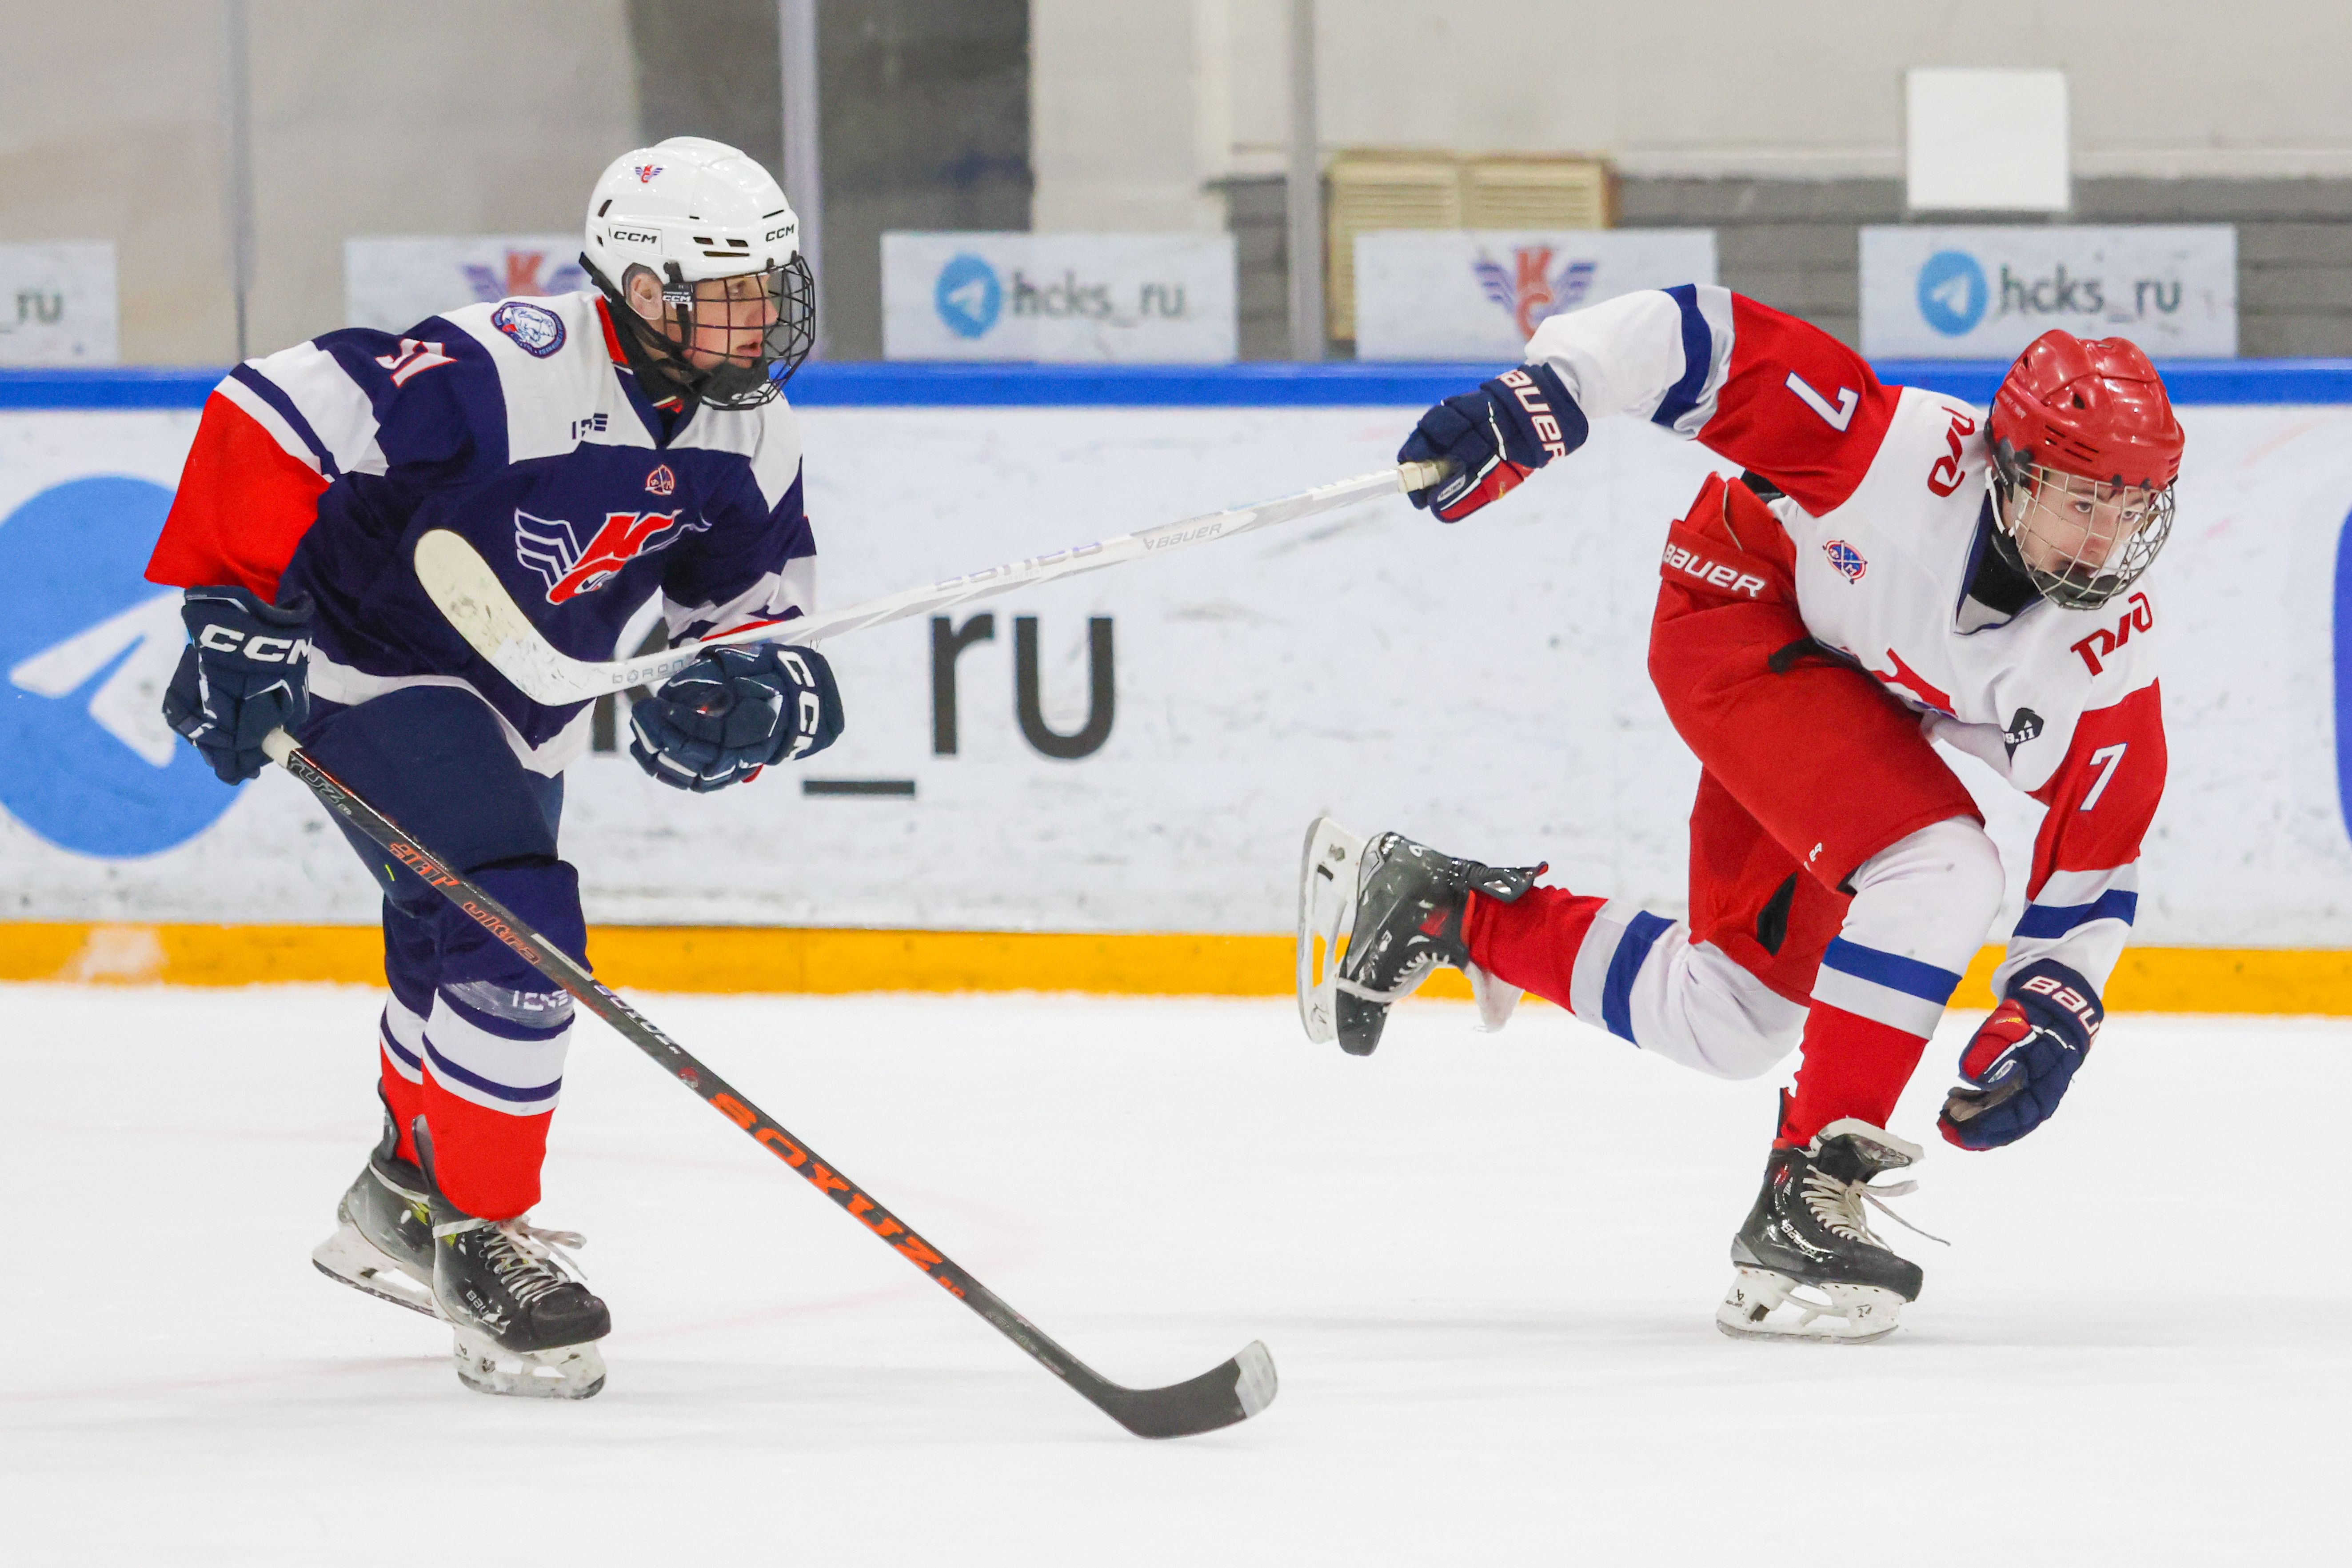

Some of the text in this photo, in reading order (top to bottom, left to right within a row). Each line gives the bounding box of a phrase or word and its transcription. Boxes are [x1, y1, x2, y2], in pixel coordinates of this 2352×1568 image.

[614, 231, 657, 243] CCM
[766, 223, 794, 241] CCM
[1012, 269, 1186, 328] hcks_ru
[2000, 265, 2182, 323] hcks_ru
[1495, 369, 1566, 464] AUER
[1784, 370, 1860, 432] 7
[1663, 543, 1765, 598] BAUER
[200, 623, 312, 665] CCM
[2003, 727, 2035, 744] 9.11
[2080, 742, 2128, 811] 7
[2019, 975, 2101, 1049] BAU
[708, 1093, 942, 1271] SOYUZ
